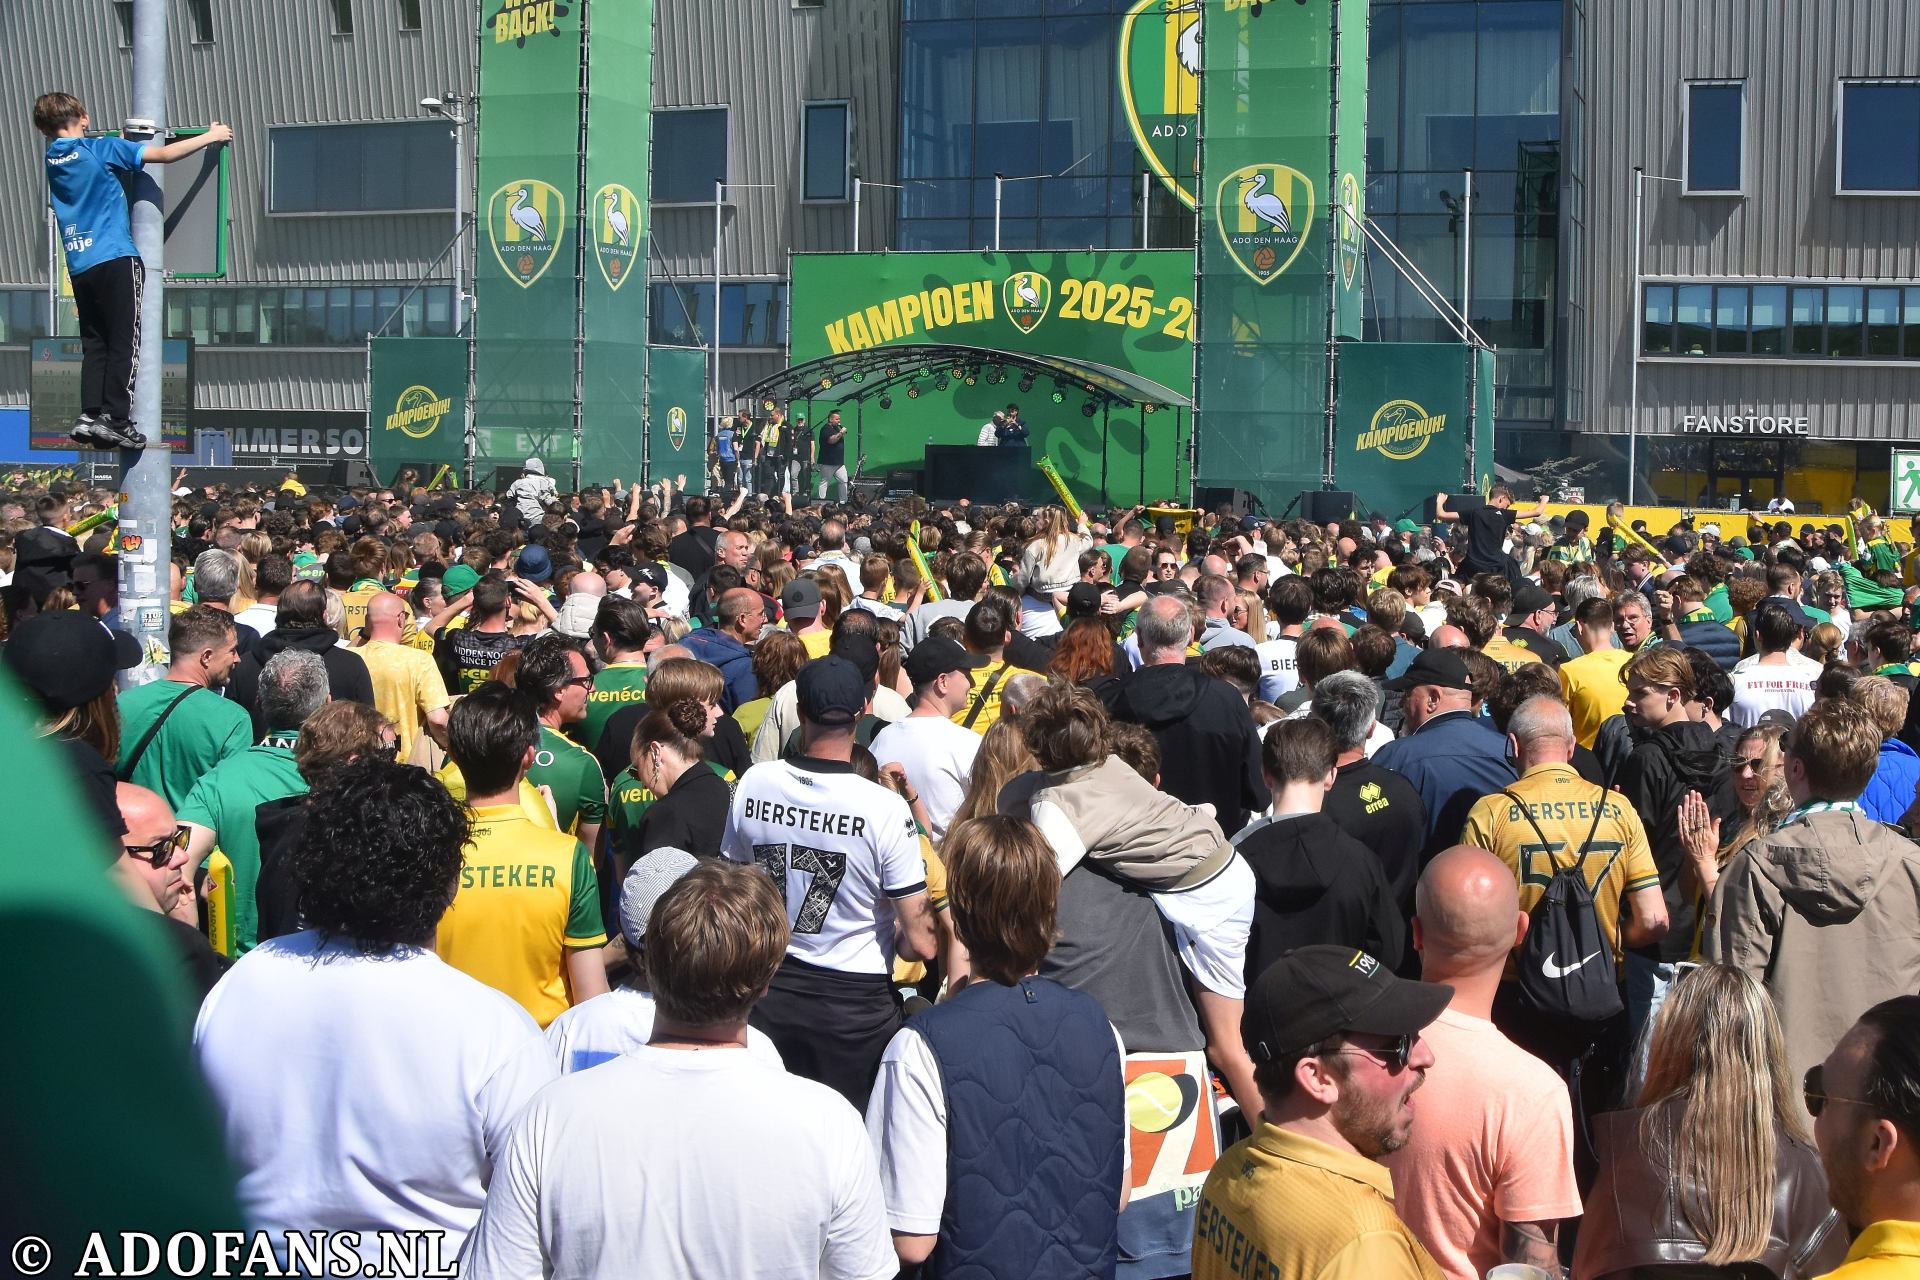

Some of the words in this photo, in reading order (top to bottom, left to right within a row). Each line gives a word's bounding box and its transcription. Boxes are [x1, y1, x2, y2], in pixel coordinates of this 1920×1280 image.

[495, 1, 555, 44] BACK!
[1151, 124, 1188, 137] ADO
[65, 236, 93, 253] oije
[501, 245, 515, 253] ADO
[533, 244, 553, 252] HAAG
[1232, 237, 1251, 245] ADO
[1274, 235, 1298, 244] HAAG
[824, 280, 994, 355] KAMPIOEN
[385, 398, 451, 431] KAMPIOENUH!
[1356, 414, 1447, 451] KAMPIOENUH!
[1684, 415, 1809, 435] FANSTORE
[515, 433, 562, 453] EXIT
[460, 656, 487, 666] SINCE
[1747, 681, 1764, 690] FIT
[1766, 680, 1783, 689] FOR
[798, 776, 814, 787] 1905
[620, 787, 658, 803] ven
[1365, 797, 1389, 814] errea
[744, 797, 866, 838] BIERSTEKER
[462, 864, 556, 889] STEKER
